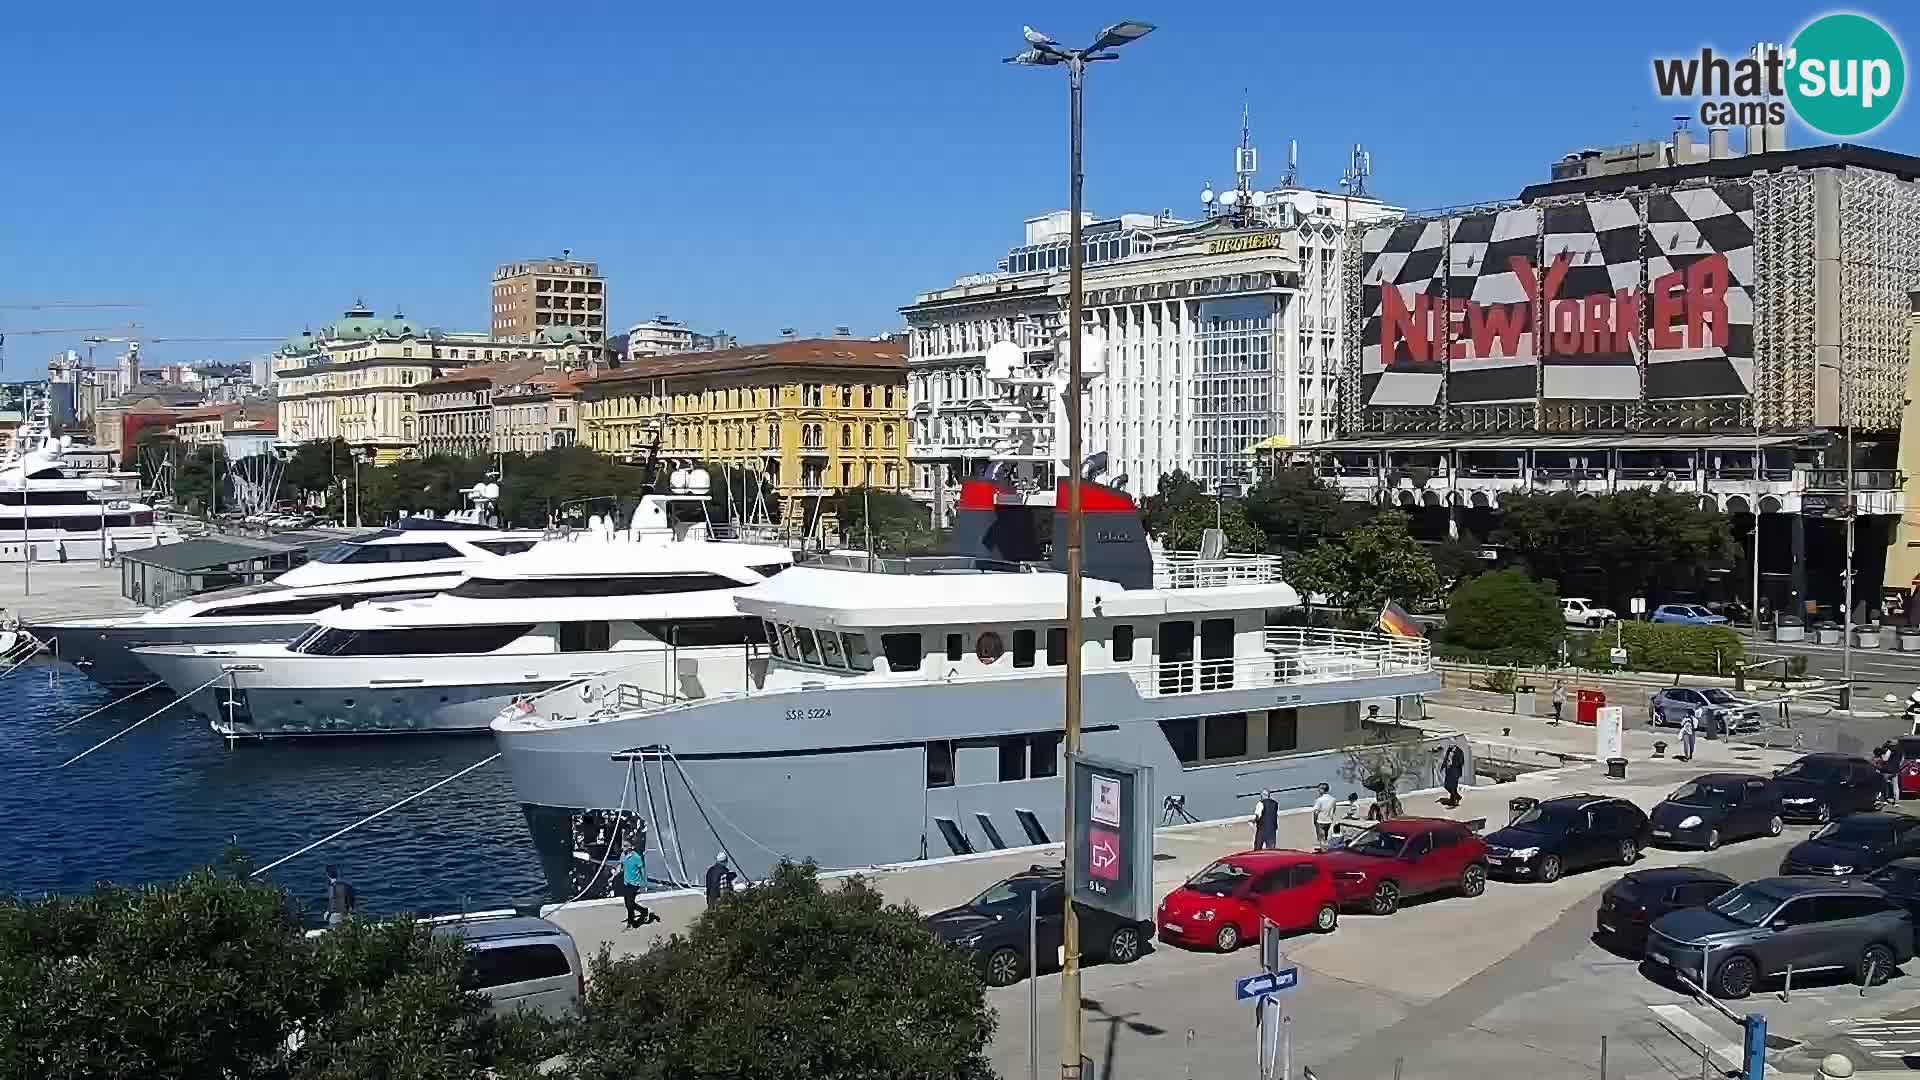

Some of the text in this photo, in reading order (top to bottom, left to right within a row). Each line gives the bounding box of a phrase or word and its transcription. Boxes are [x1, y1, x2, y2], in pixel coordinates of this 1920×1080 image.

[1381, 251, 1728, 364] NEW YORKER
[785, 708, 832, 721] SSR 5224
